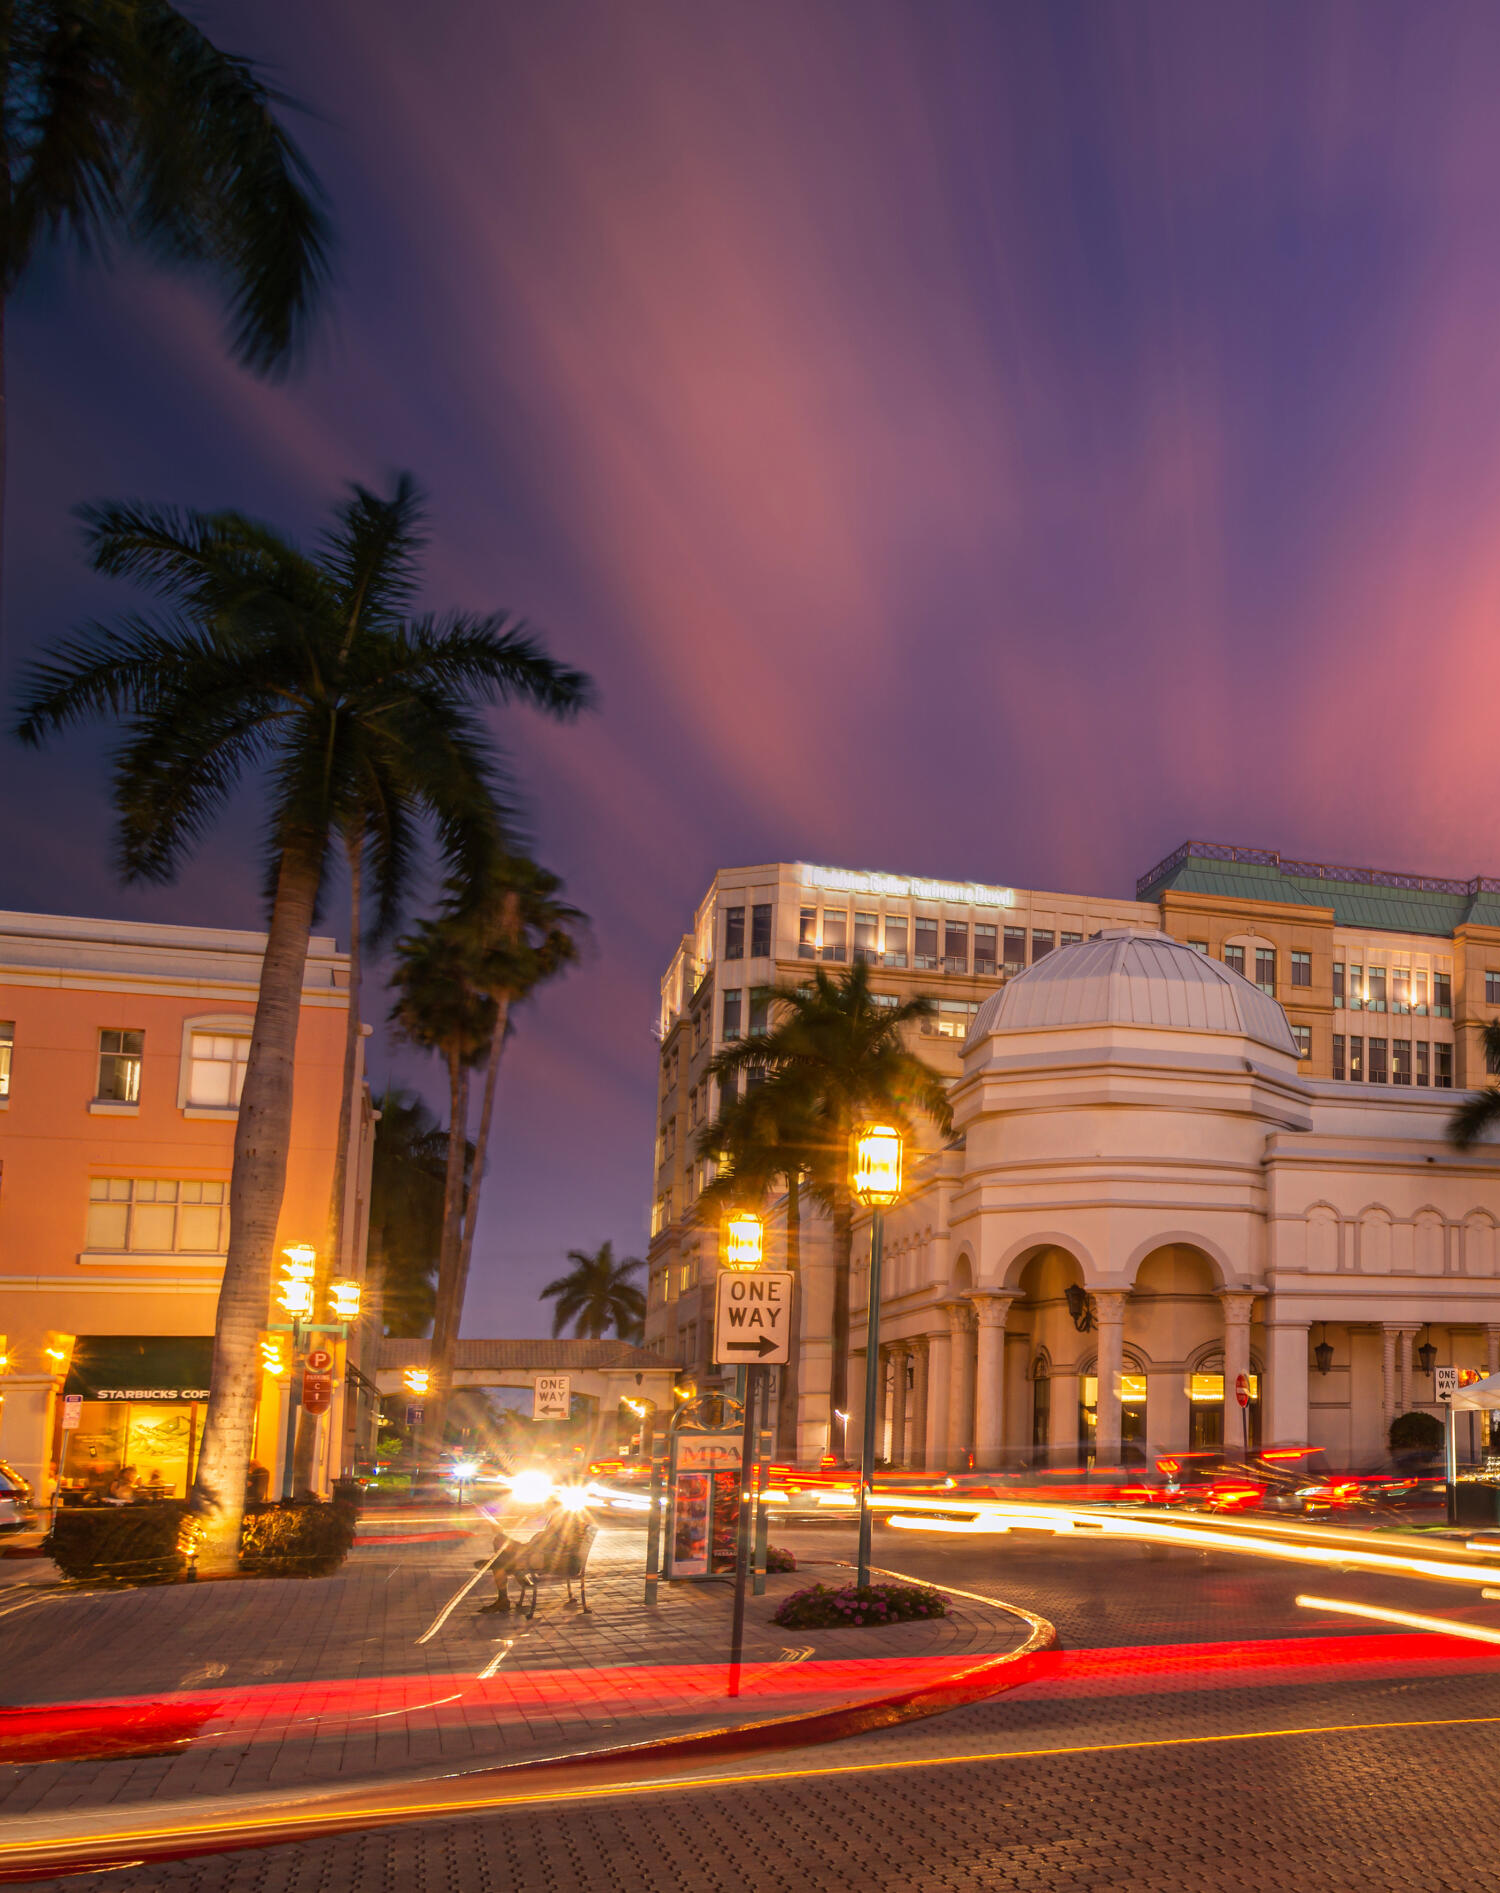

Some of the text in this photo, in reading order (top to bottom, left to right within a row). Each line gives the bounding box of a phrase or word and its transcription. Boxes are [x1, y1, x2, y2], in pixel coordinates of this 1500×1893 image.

[731, 1281, 781, 1301] ONE
[727, 1306, 782, 1328] WAY
[315, 1353, 327, 1367] P
[1439, 1370, 1456, 1379] ONE
[540, 1379, 566, 1389] ONE
[1438, 1380, 1456, 1389] WAY
[97, 1390, 178, 1399] STARBUCKS
[539, 1391, 565, 1401] WAY
